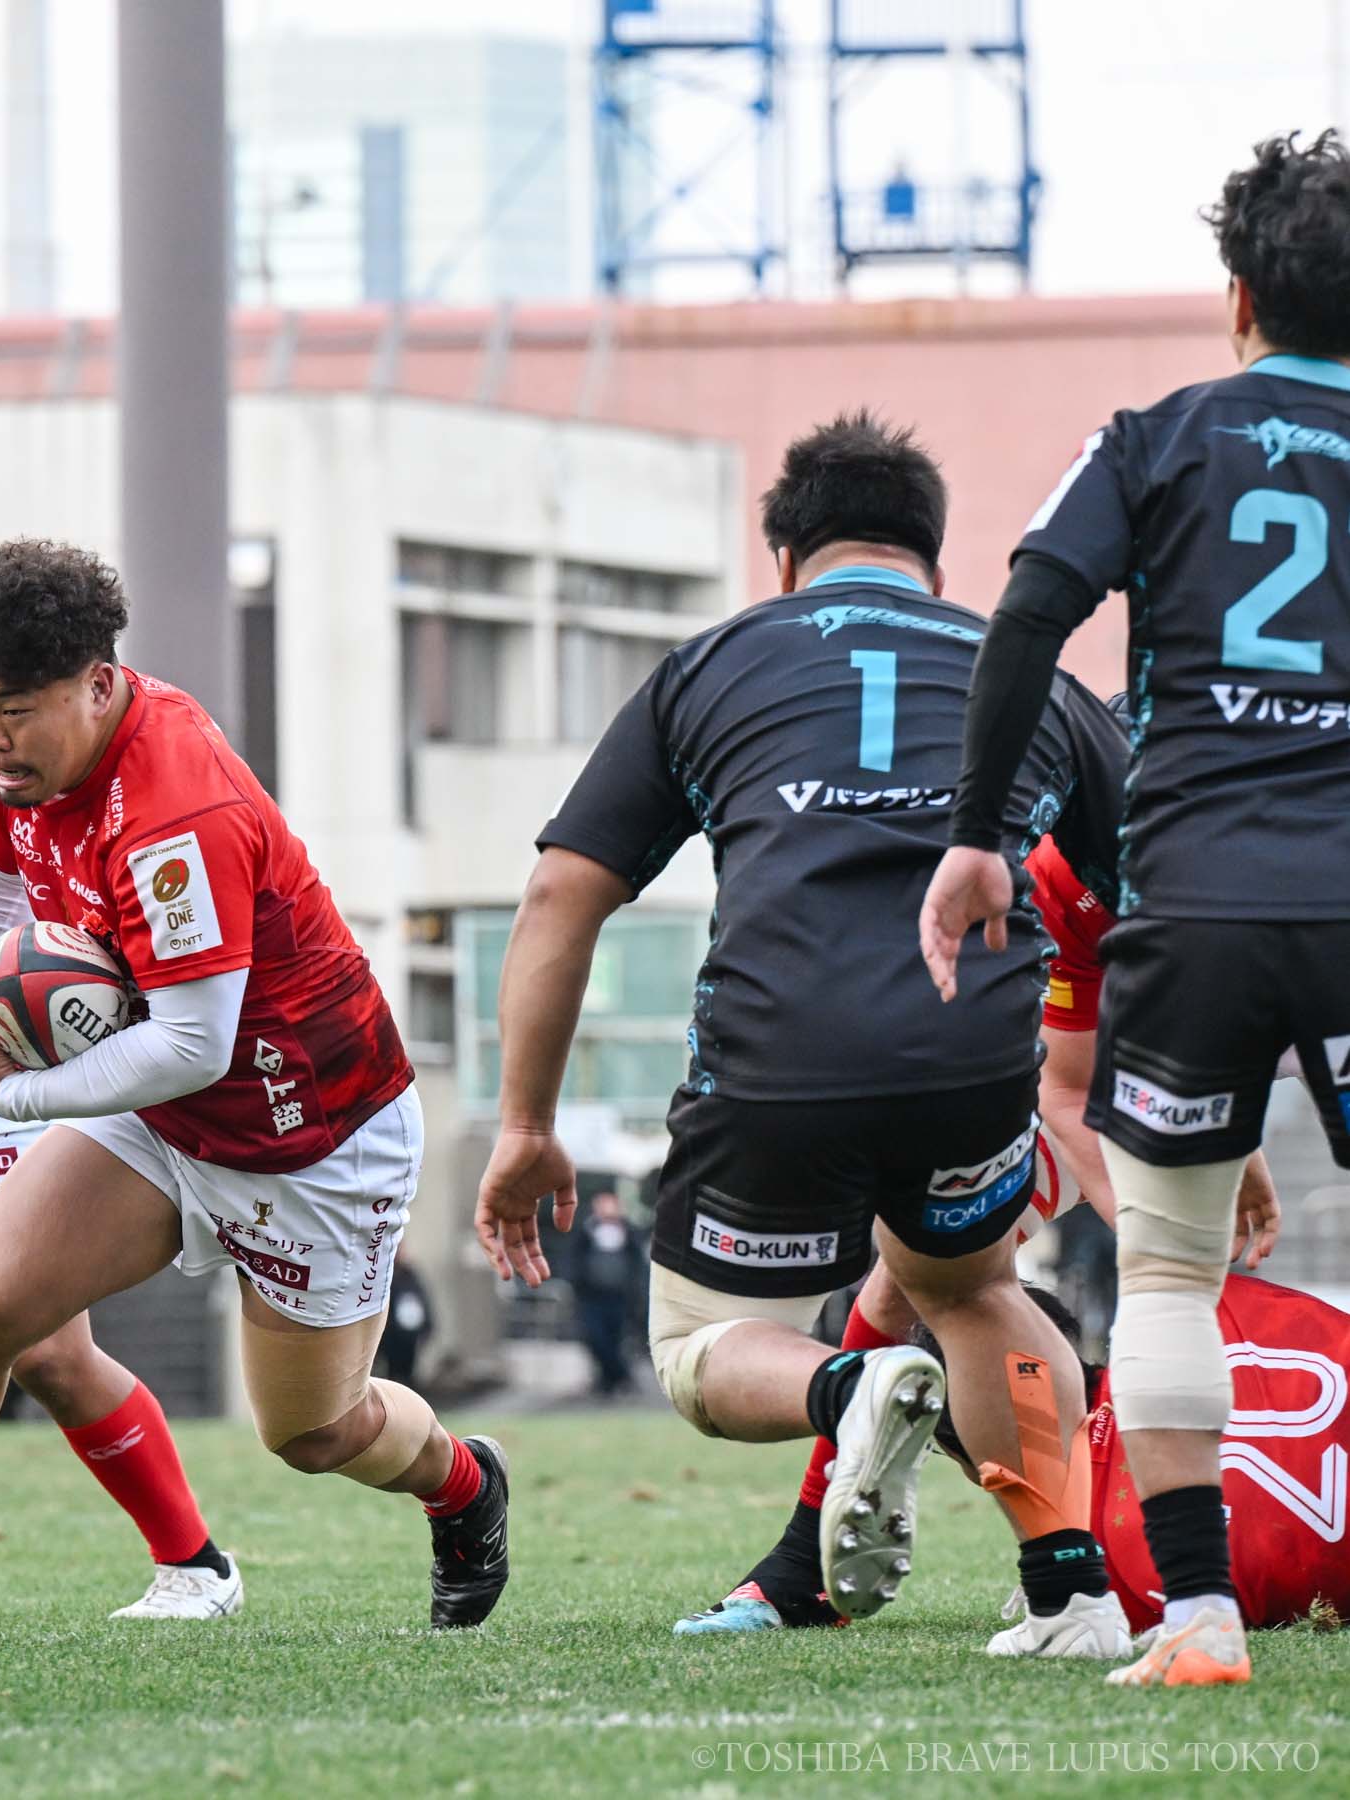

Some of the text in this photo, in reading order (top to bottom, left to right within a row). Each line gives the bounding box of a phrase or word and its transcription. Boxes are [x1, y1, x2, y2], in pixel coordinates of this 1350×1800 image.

[1222, 488, 1350, 674] 2
[851, 650, 896, 772] 1
[1256, 697, 1350, 729] バンテ
[167, 909, 194, 930] ONE
[182, 933, 203, 946] NTT
